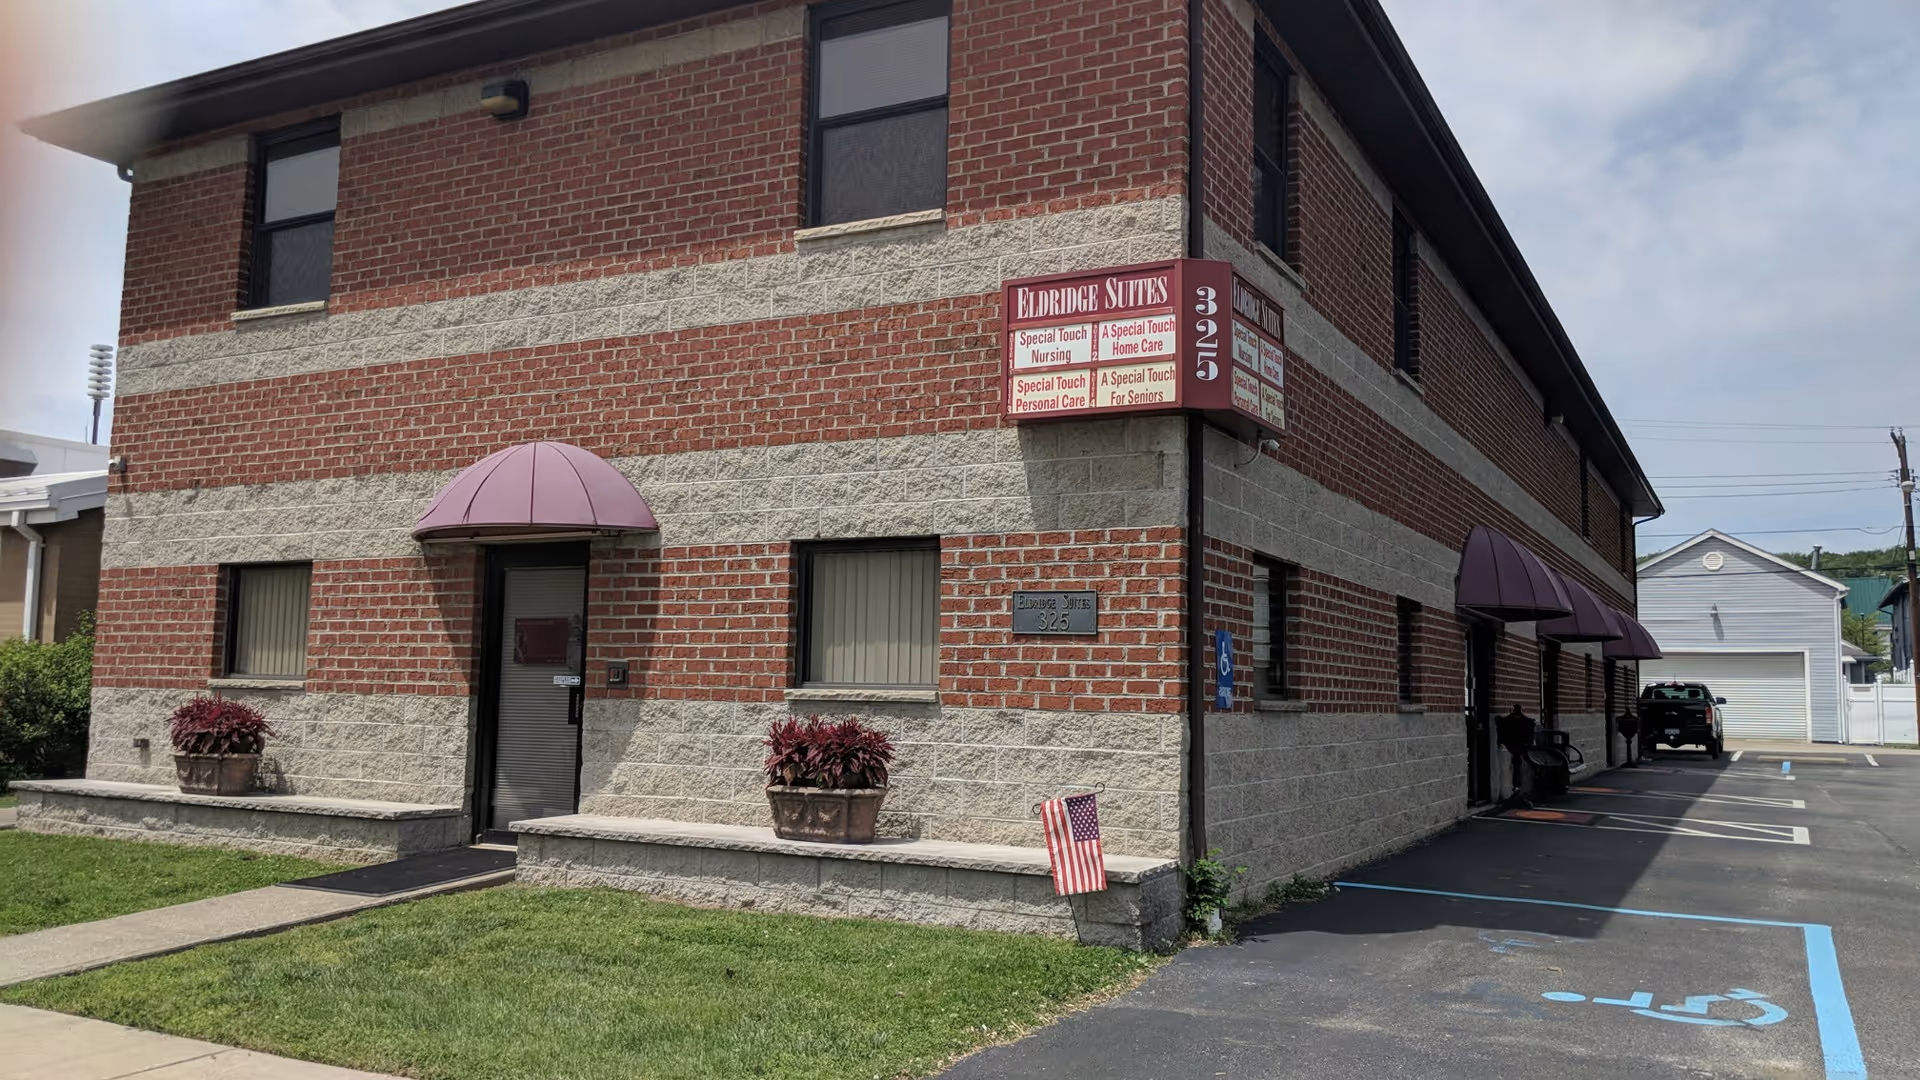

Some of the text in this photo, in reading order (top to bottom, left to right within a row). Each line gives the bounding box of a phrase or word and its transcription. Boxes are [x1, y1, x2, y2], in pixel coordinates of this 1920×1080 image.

[1016, 276, 1168, 319] ELDRIDGE SUITES
[1019, 325, 1087, 349] Special Touch
[1102, 317, 1175, 340] A Special Touch
[1195, 286, 1218, 381] 325
[1031, 347, 1072, 364] Nursing
[1112, 338, 1163, 356] Home Care
[1017, 373, 1086, 396] Special Touch
[1101, 365, 1175, 389] A Special Touch
[1016, 394, 1085, 412] Personal Care
[1111, 388, 1164, 405] For Seniors
[1018, 593, 1091, 609] ELDRIDGE SUITES
[1038, 610, 1070, 631] 325
